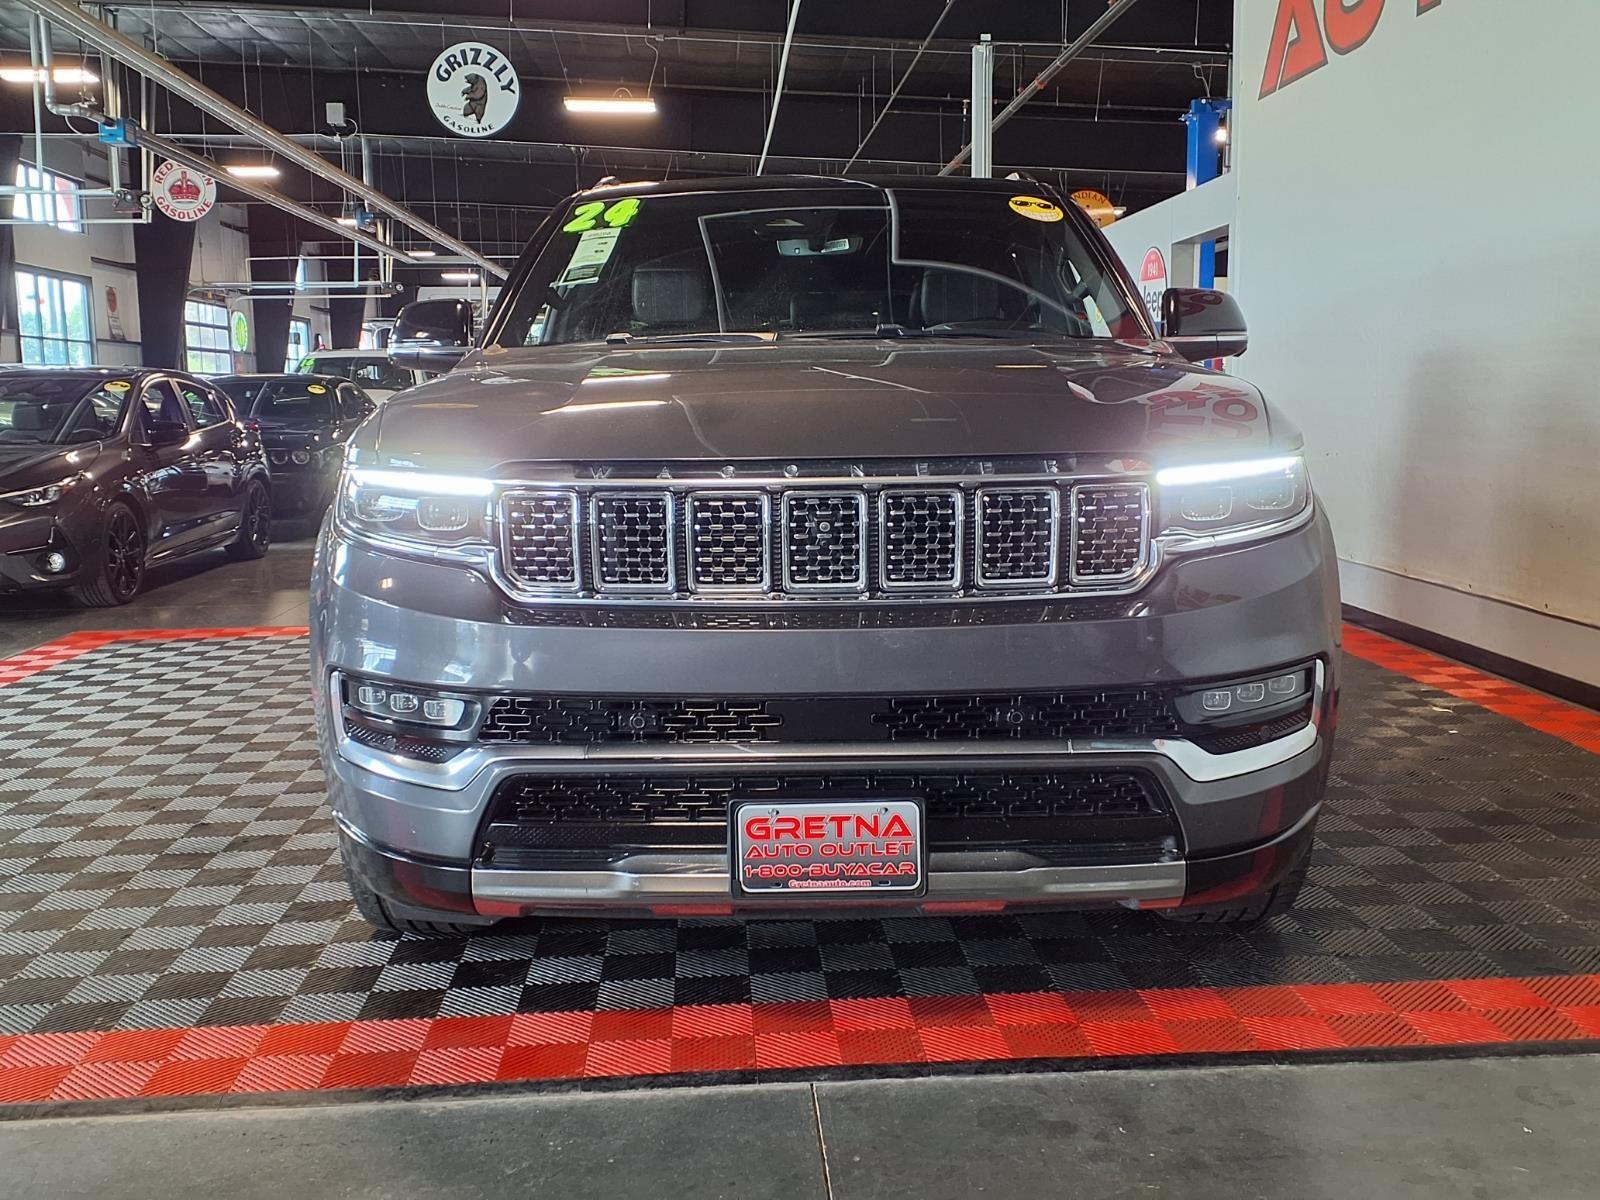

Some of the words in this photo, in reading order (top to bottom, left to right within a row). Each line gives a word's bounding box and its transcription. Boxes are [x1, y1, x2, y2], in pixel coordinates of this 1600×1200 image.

[436, 47, 516, 95] GRIZZLY
[443, 115, 495, 133] GASOLINE
[154, 161, 174, 184] RED
[156, 195, 212, 220] GASOLINE
[1073, 191, 1106, 205] NDIAN
[562, 198, 641, 232] 24
[1147, 261, 1159, 277] 1941
[589, 459, 1059, 480] WAGONEER
[745, 813, 914, 841] GRETNA
[744, 843, 812, 860] AUTO
[819, 841, 915, 857] OUTLET
[744, 862, 915, 878] 1-800-BUYACAR
[788, 879, 872, 888] Gretnaauto.com
